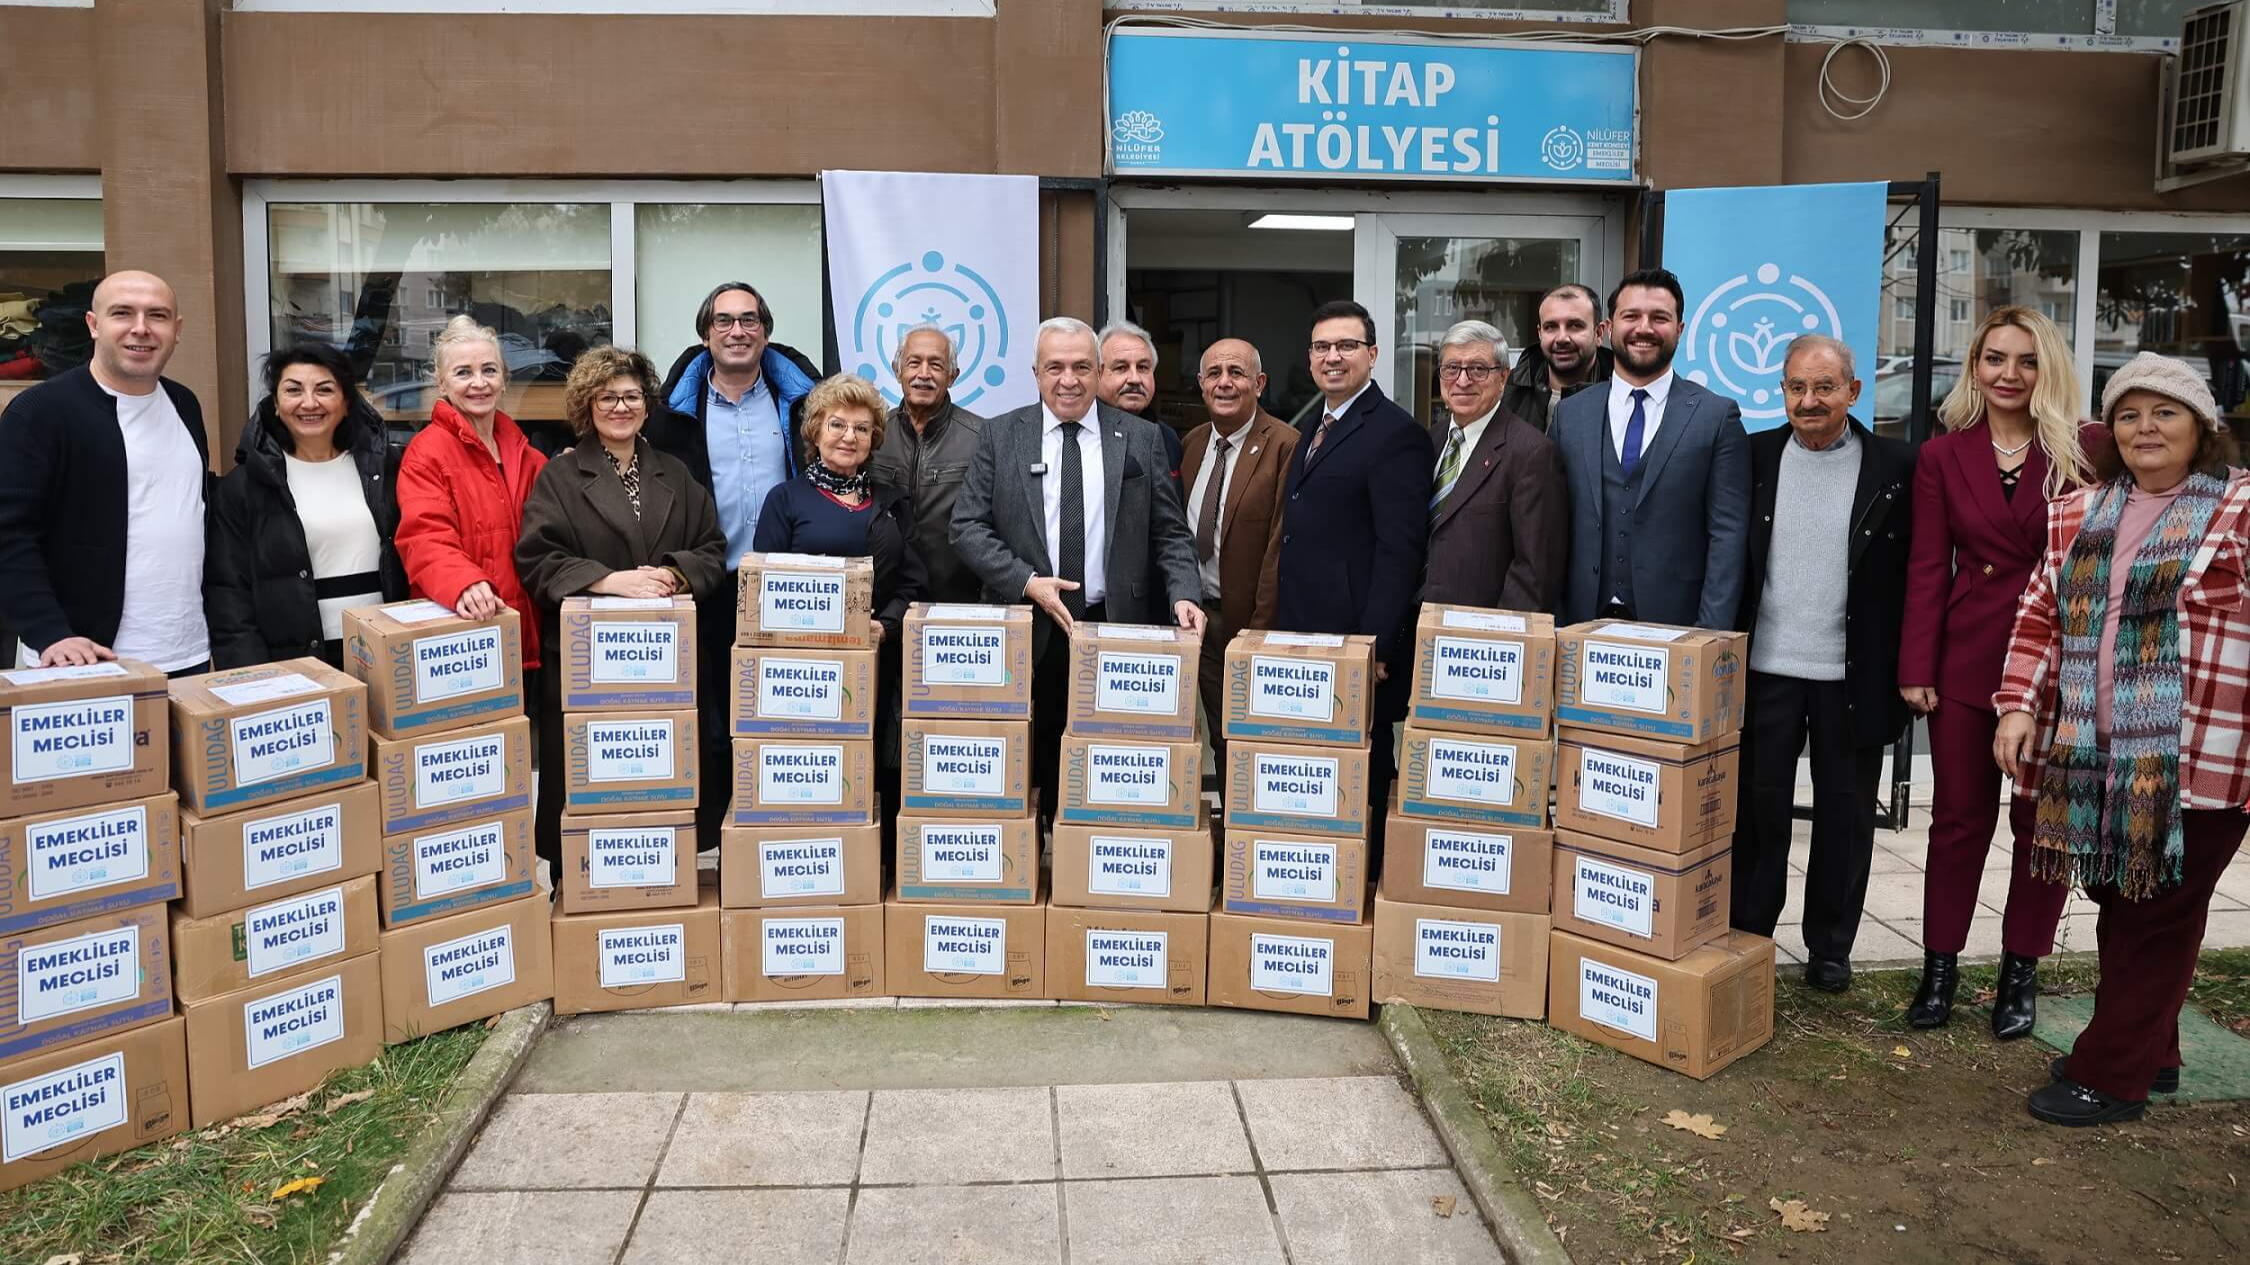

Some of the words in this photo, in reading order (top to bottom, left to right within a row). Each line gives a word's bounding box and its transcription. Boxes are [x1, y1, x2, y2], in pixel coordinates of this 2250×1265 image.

[1298, 46, 1456, 106] KİTAP
[1246, 110, 1500, 174] ATÖLYESİ
[1587, 127, 1630, 141] NİLÜFER
[1116, 143, 1161, 152] NİLÜFER
[767, 579, 840, 594] EMEKLİLER
[774, 596, 831, 611] MECLİSİ
[597, 629, 672, 644] EMEKLİLER
[928, 632, 1000, 648] EMEKLİLER
[420, 637, 495, 661] EMEKLİLER
[566, 613, 591, 690] ULUDAĞ
[605, 646, 663, 661] MECLİSİ
[936, 649, 991, 665] MECLİSİ
[1441, 646, 1516, 663] EMEKLİLER
[429, 652, 488, 678] MECLİSİ
[1103, 660, 1175, 676] EMEKLİLER
[1589, 651, 1662, 671] EMEKLİLER
[394, 642, 414, 711] ULUDAĞ
[765, 666, 837, 681] EMEKLİLER
[1074, 643, 1098, 718] ULUDAĞ
[1257, 665, 1329, 683] EMEKLİLER
[1448, 664, 1507, 681] MECLİSİ
[1559, 640, 1578, 706] ULUDAĞ
[1595, 669, 1653, 688] MECLİSİ
[737, 657, 756, 720] ULUDAĞ
[772, 683, 828, 699] MECLİSİ
[1110, 678, 1166, 693] MECLİSİ
[1230, 660, 1248, 721] ULUDAĞ
[1264, 683, 1320, 699] MECLİSİ
[20, 707, 125, 733] EMEKLİLER
[238, 711, 324, 742] EMEKLİLER
[33, 727, 114, 754] MECLİSİ
[250, 728, 317, 759] MECLİSİ
[593, 726, 667, 743] EMEKLİLER
[204, 717, 228, 792] ULUDAĞ
[421, 744, 498, 768] EMEKLİLER
[569, 725, 588, 787] ULUDAĞ
[601, 743, 659, 760] MECLİSİ
[765, 752, 837, 767] EMEKLİLER
[929, 743, 1000, 758] EMEKLİLER
[1435, 748, 1509, 766] EMEKLİLER
[906, 731, 924, 790] ULUDAĞ
[936, 759, 992, 775] MECLİSİ
[1093, 752, 1164, 768] EMEKLİLER
[430, 759, 490, 784] MECLİSİ
[736, 749, 753, 810] ULUDAĞ
[772, 769, 829, 784] MECLİSİ
[1066, 746, 1086, 807] ULUDAĞ
[1100, 770, 1156, 785] MECLİSİ
[1260, 762, 1332, 779] EMEKLİLER
[1406, 740, 1427, 801] ULUDAĞ
[1442, 766, 1500, 783] MECLİSİ
[1586, 758, 1654, 785] EMEKLİLER
[384, 752, 407, 820] ULUDAĞ
[1231, 751, 1249, 813] ULUDAĞ
[1267, 780, 1323, 795] MECLİSİ
[1592, 778, 1645, 802] MECLİSİ
[35, 819, 138, 851] EMEKLİLER
[250, 815, 334, 845] EMEKLİLER
[926, 831, 997, 845] EMEKLİLER
[260, 832, 325, 862] MECLİSİ
[420, 832, 497, 859] EMEKLİLER
[595, 834, 669, 850] EMEKLİLER
[1432, 838, 1505, 856] EMEKLİLER
[48, 838, 128, 870] MECLİSİ
[603, 850, 660, 867] MECLİSİ
[765, 845, 837, 861] EMEKLİLER
[902, 825, 920, 887] ULUDAĞ
[934, 847, 989, 862] MECLİSİ
[1095, 844, 1166, 859] EMEKLİLER
[1260, 850, 1330, 864] EMEKLİLER
[430, 848, 490, 875] MECLİSİ
[774, 860, 830, 877] MECLİSİ
[1102, 861, 1157, 876] MECLİSİ
[1228, 840, 1246, 900] ULUDAĞ
[1438, 856, 1496, 872] MECLİSİ
[388, 842, 411, 908] ULUDAĞ
[1267, 867, 1322, 881] MECLİSİ
[1580, 867, 1648, 896] EMEKLİLER
[1587, 887, 1639, 912] MECLİSİ
[252, 900, 337, 933] EMEKLİLER
[263, 917, 329, 950] MECLİSİ
[767, 924, 838, 939] EMEKLİLER
[930, 924, 1000, 939] EMEKLİLER
[1422, 928, 1494, 944] EMEKLİLER
[606, 934, 678, 948] EMEKLİLER
[775, 940, 830, 955] MECLİSİ
[937, 939, 992, 954] MECLİSİ
[1092, 937, 1162, 952] EMEKLİLER
[27, 939, 130, 973] EMEKLİLER
[431, 936, 505, 967] EMEKLİLER
[614, 948, 670, 966] MECLİSİ
[1257, 943, 1327, 958] EMEKLİLER
[1429, 945, 1486, 960] MECLİSİ
[441, 951, 499, 982] MECLİSİ
[1099, 953, 1154, 968] MECLİSİ
[1264, 960, 1319, 975] MECLİSİ
[39, 958, 120, 993] MECLİSİ
[1585, 968, 1652, 1000] EMEKLİLER
[252, 988, 335, 1025] EMEKLİLER
[1591, 988, 1644, 1016] MECLİSİ
[263, 1005, 327, 1041] MECLİSİ
[8, 1066, 116, 1114] EMEKLİLER
[23, 1086, 106, 1129] MECLİSİ
